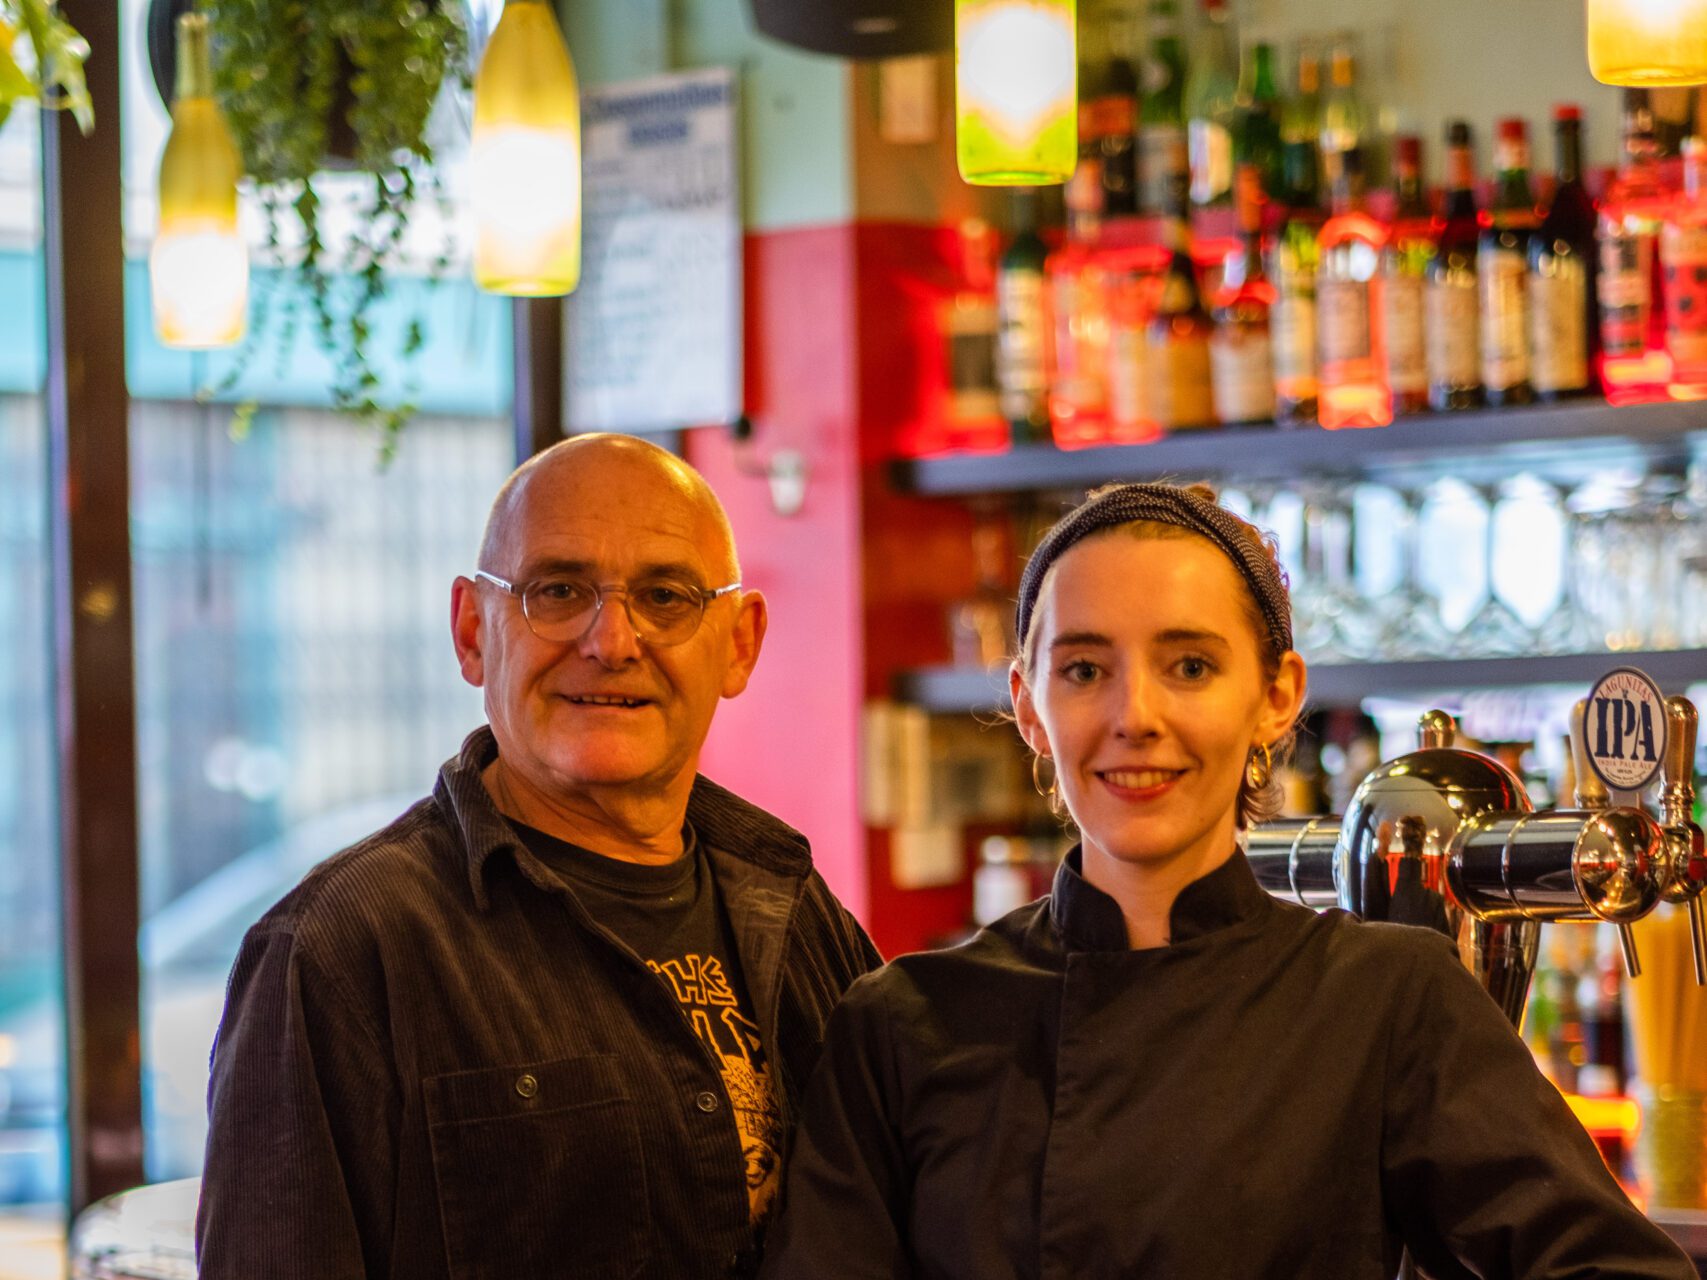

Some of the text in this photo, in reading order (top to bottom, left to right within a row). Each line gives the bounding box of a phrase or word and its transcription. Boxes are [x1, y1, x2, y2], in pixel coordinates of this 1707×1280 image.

[1599, 675, 1653, 700] LAGUNITAS
[1595, 698, 1657, 761] IPA
[1620, 760, 1636, 768] PALE
[1639, 762, 1652, 770] ALE
[646, 953, 738, 1007] HE
